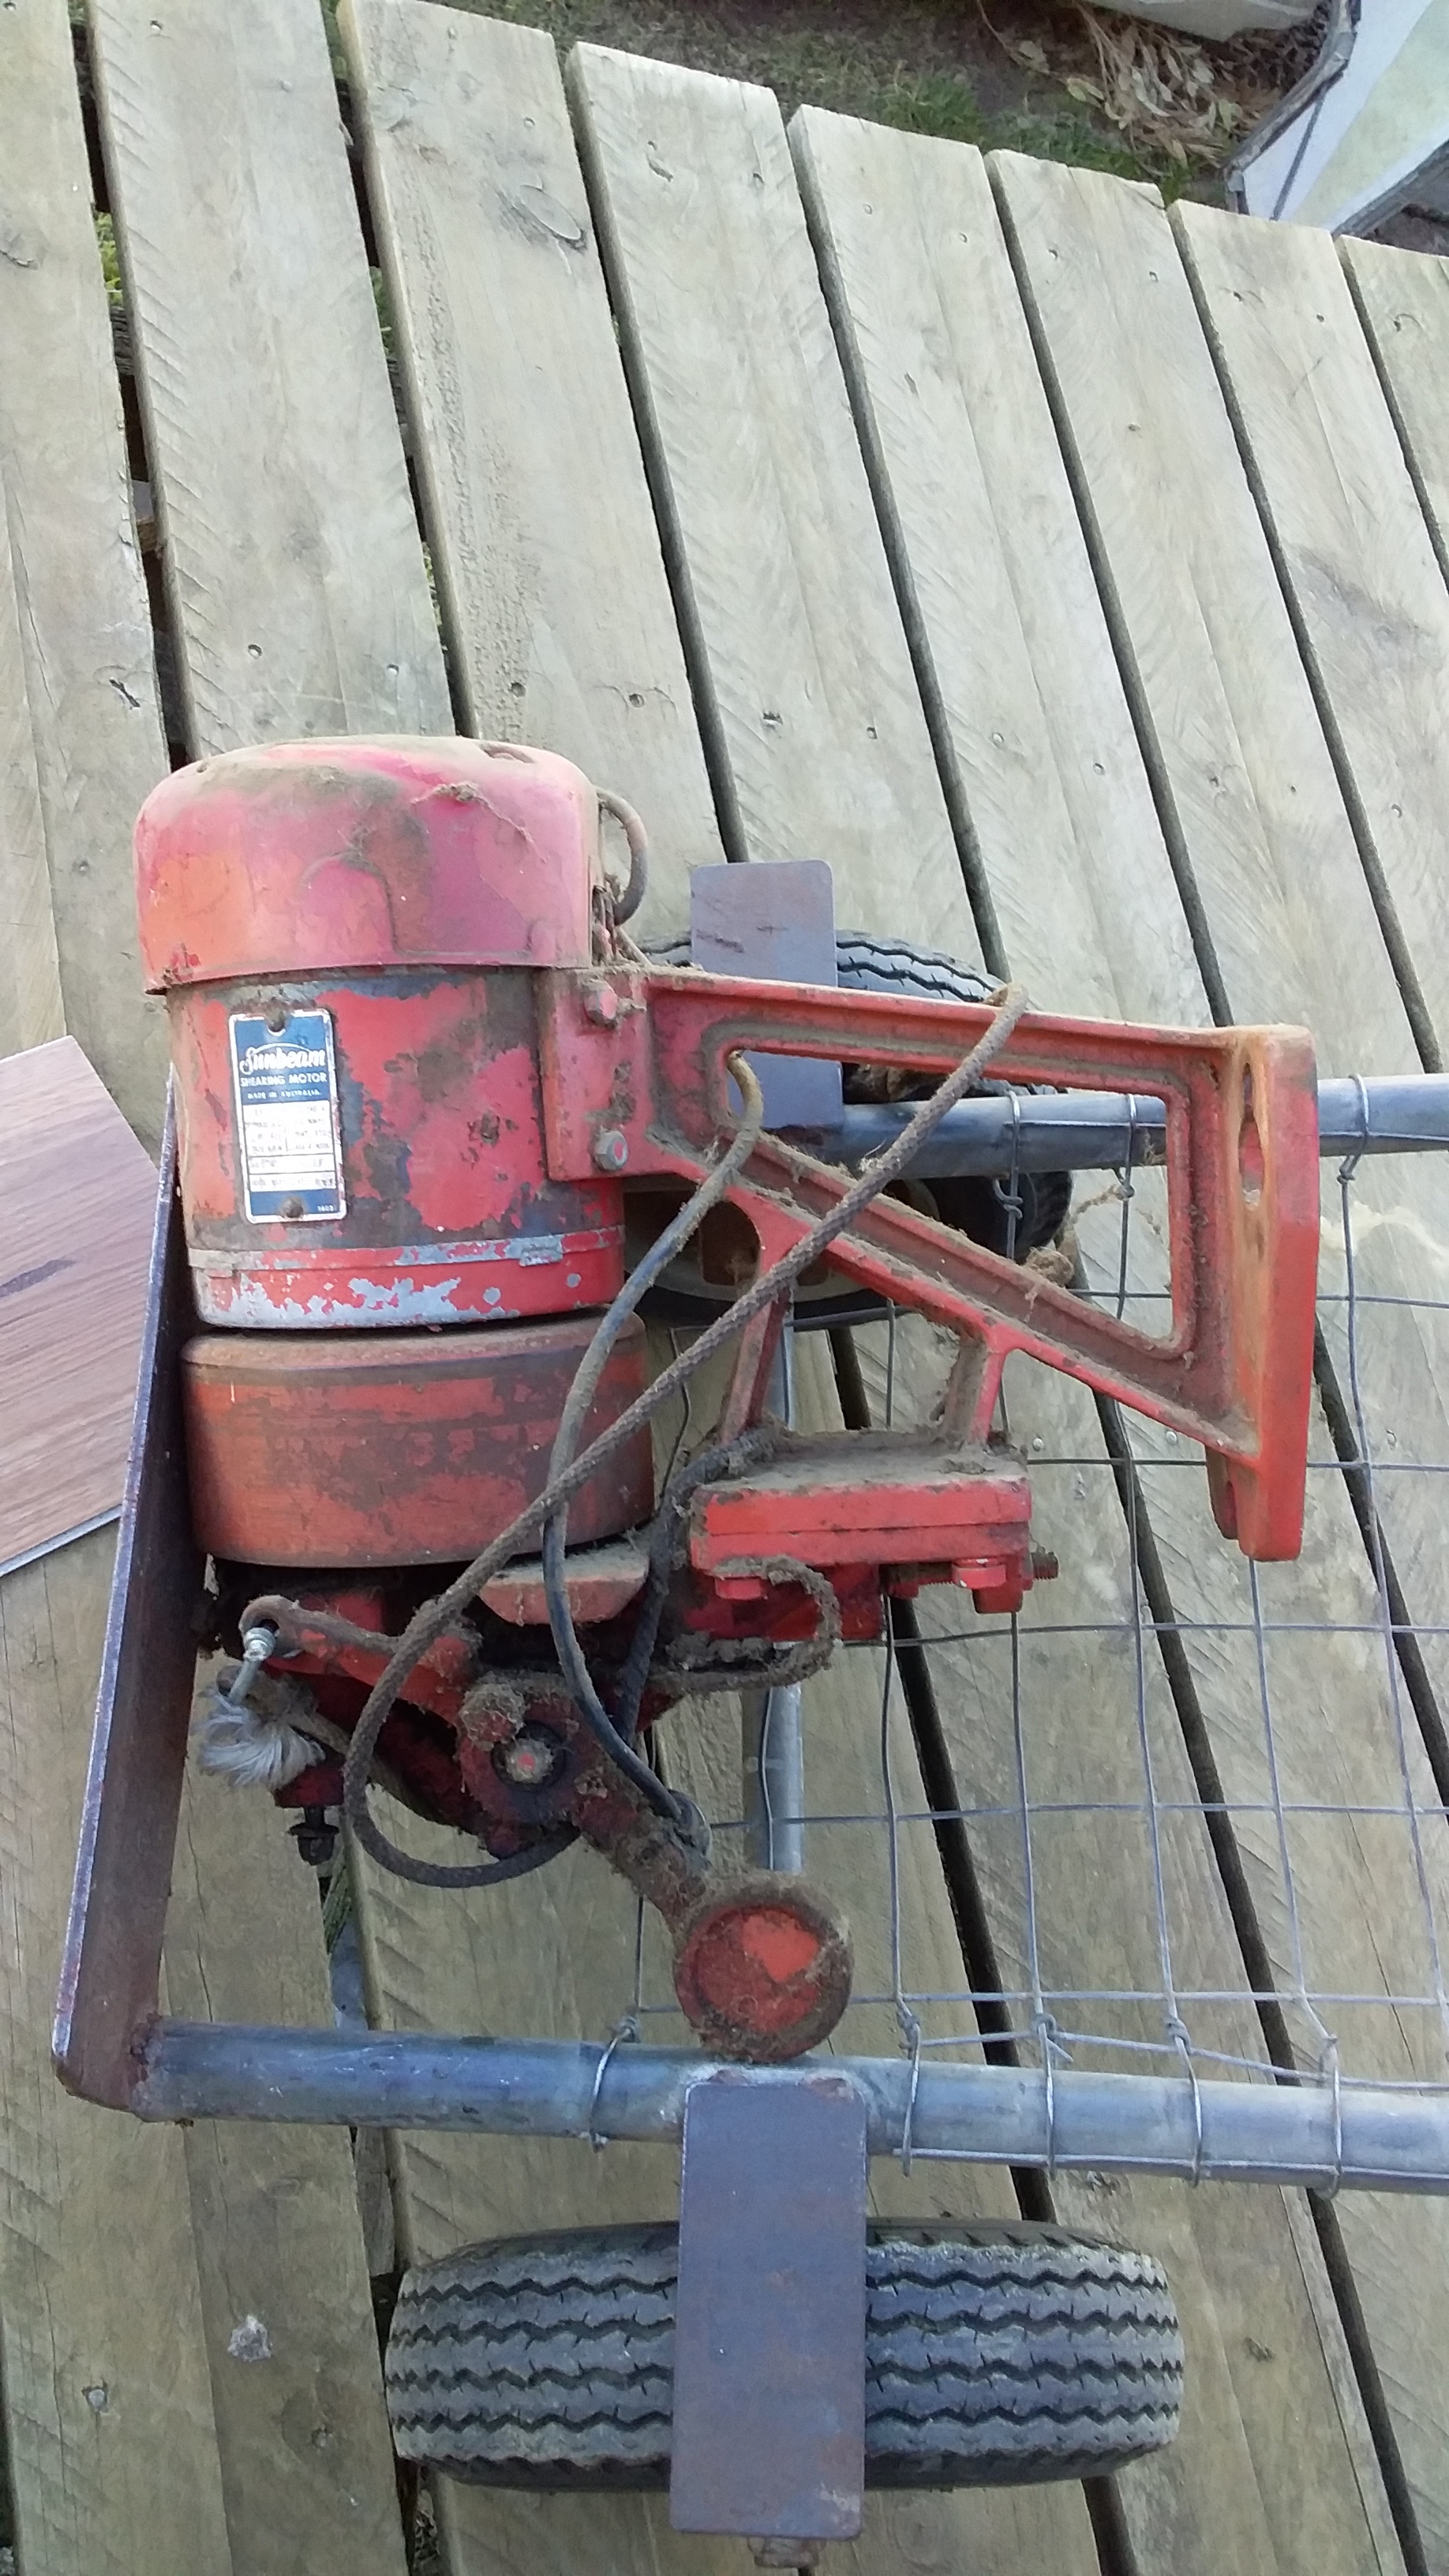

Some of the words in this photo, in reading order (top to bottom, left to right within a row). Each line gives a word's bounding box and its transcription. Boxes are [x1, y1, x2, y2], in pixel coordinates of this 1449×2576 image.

[239, 1045, 326, 1075] Sunbeam
[240, 1076, 286, 1087] SHEARING
[289, 1073, 328, 1084] MOTOR
